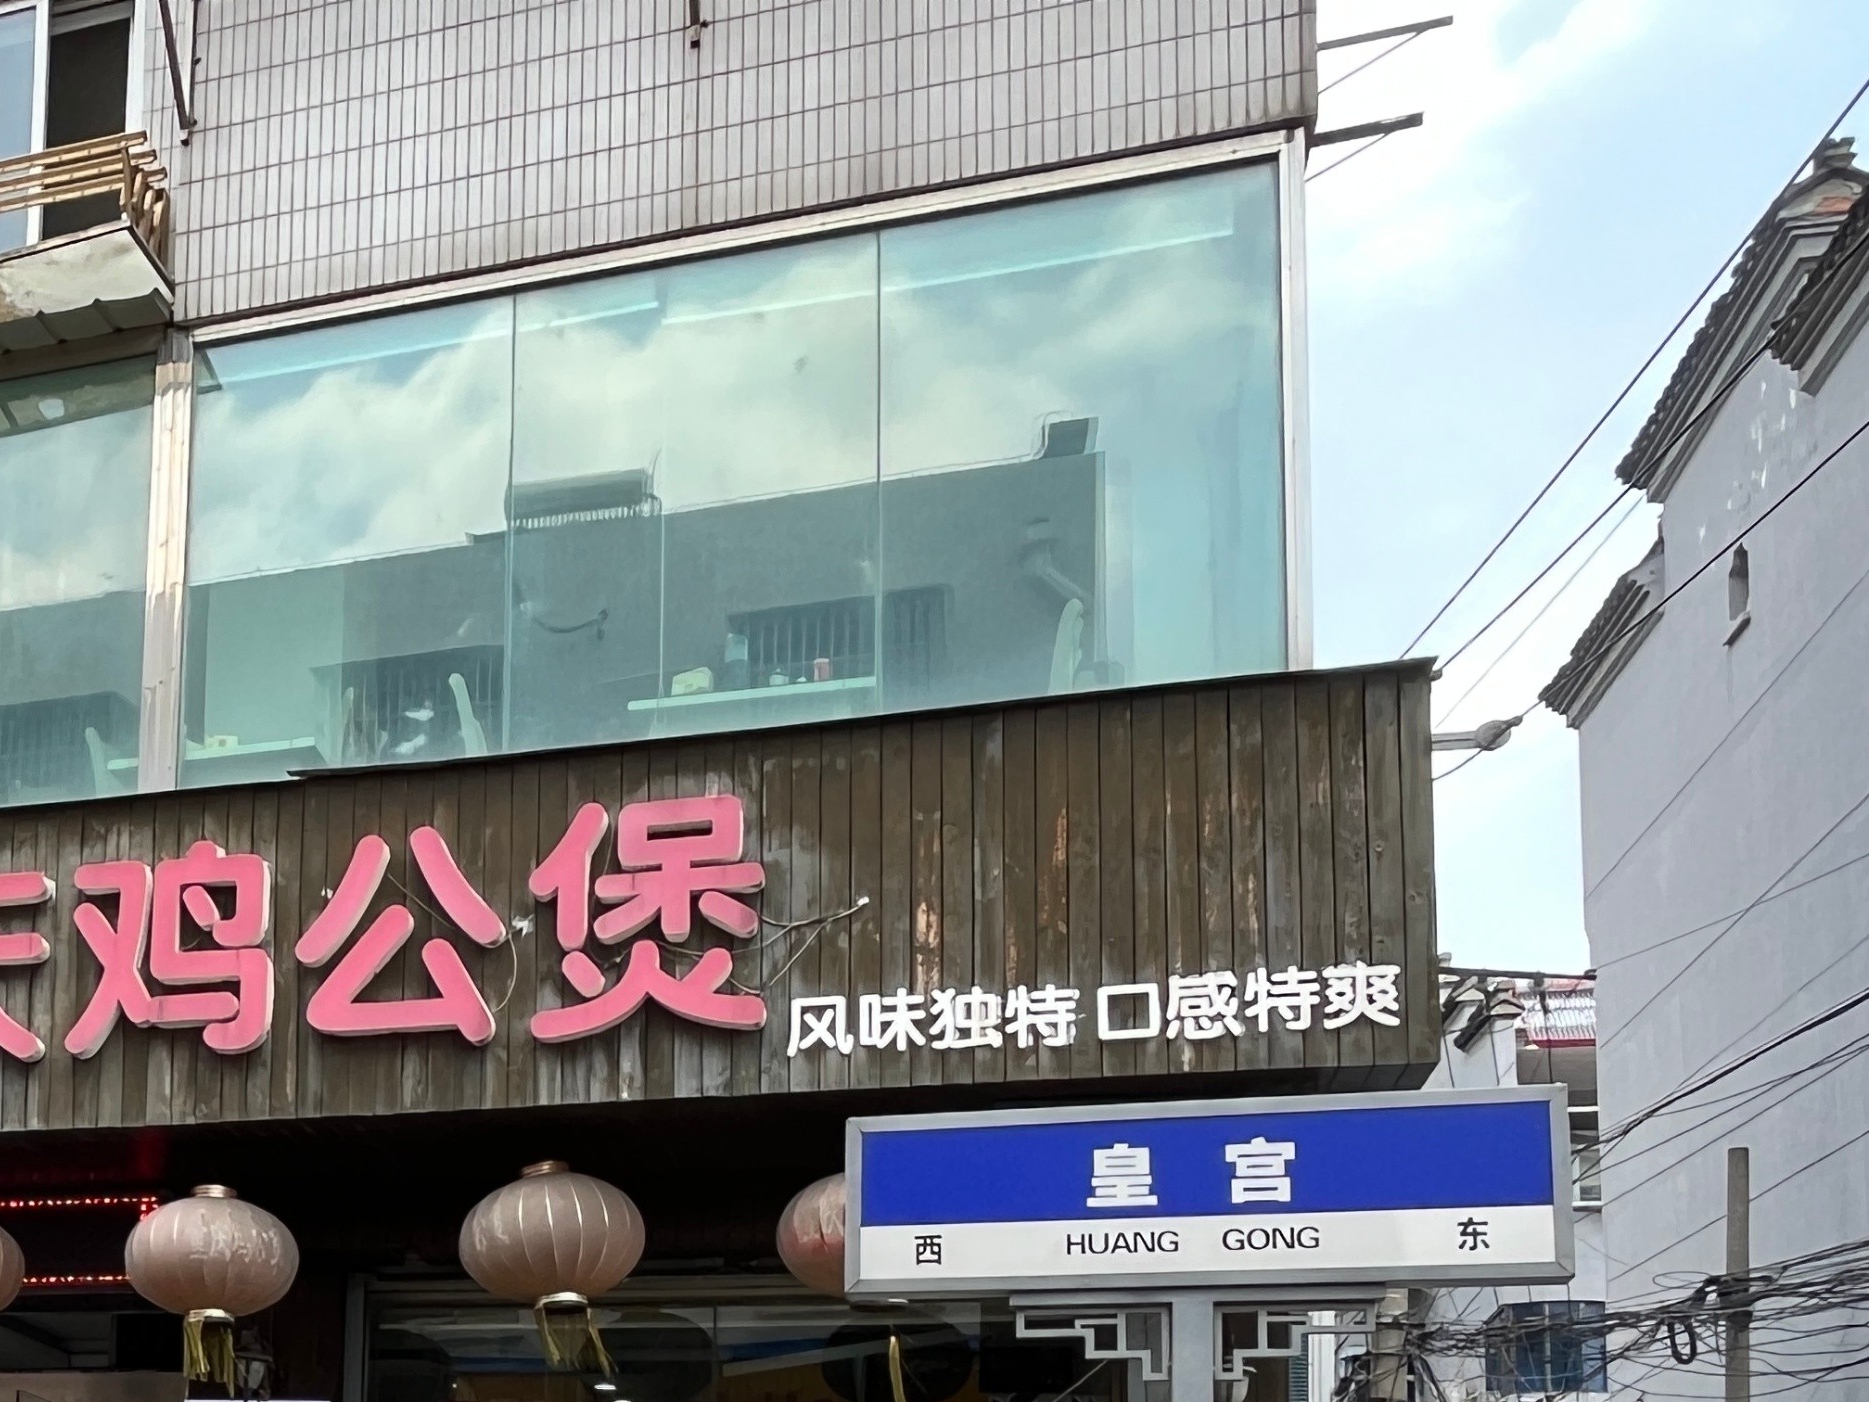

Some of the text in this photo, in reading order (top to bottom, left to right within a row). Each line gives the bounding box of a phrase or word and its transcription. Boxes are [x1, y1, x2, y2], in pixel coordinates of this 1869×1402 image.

[786, 961, 1402, 1057] 风味独特 口感特爽
[1086, 1137, 1297, 1209] 皇宫
[913, 1235, 943, 1266] 西
[1065, 1225, 1321, 1256] HUANG GONG
[1456, 1216, 1491, 1252] 东
